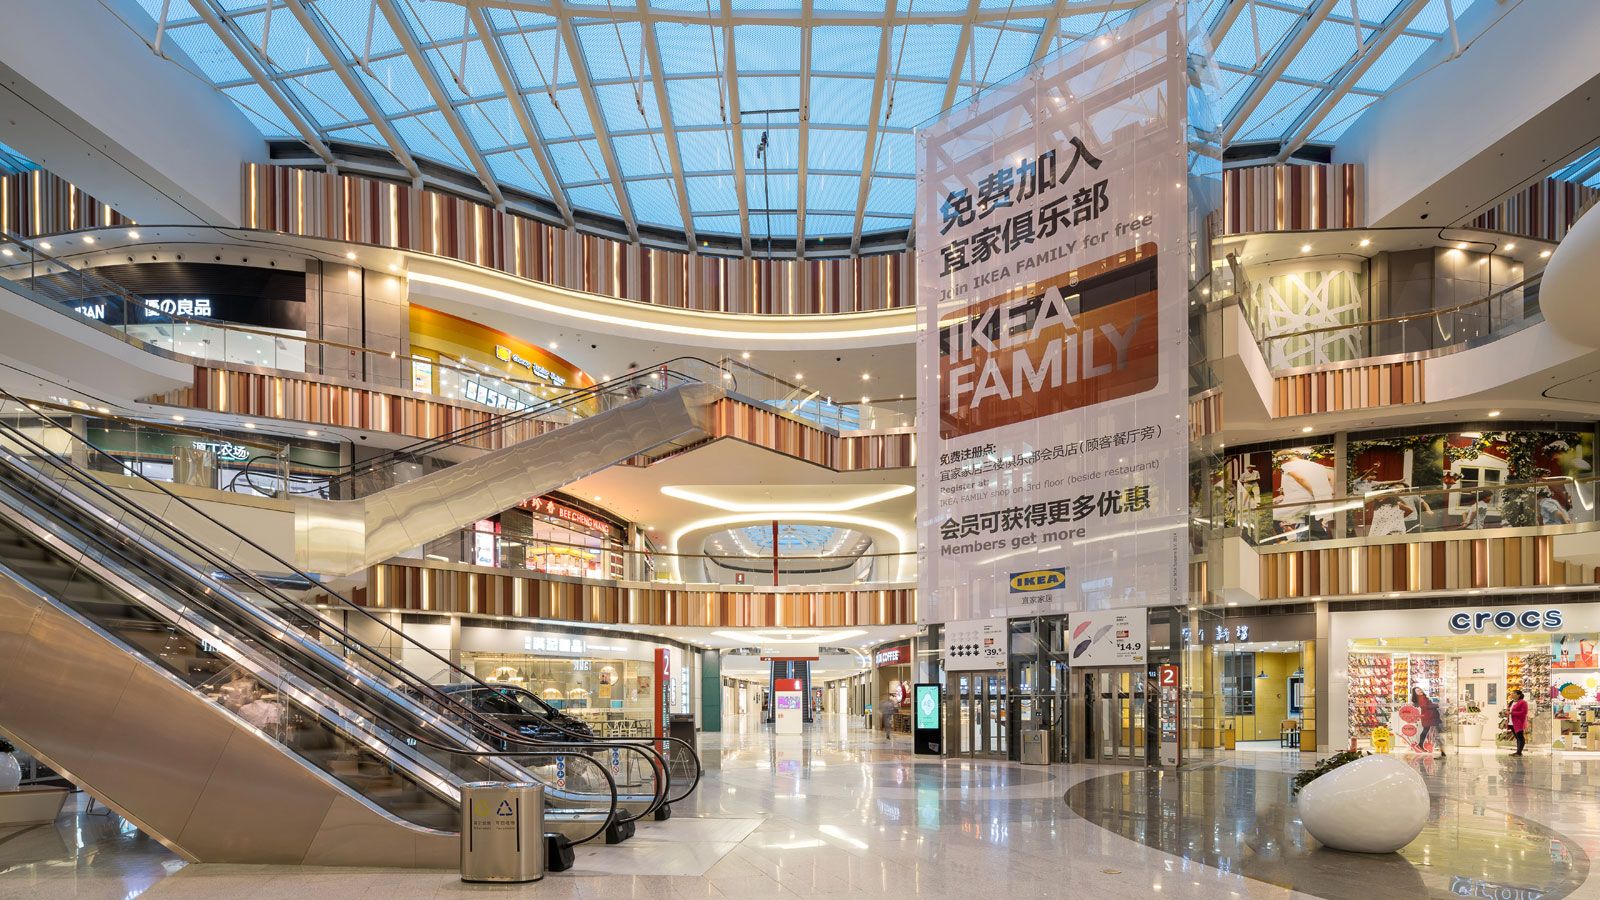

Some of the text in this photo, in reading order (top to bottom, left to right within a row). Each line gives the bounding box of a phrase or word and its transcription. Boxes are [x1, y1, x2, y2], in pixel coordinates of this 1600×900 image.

[940, 136, 1102, 236] 免费加入
[940, 179, 1109, 277] 宜家俱乐部
[940, 214, 1153, 302] Join IKEA FAMILY for free
[950, 285, 1077, 365] IKEA
[950, 313, 1144, 415] FAMILY
[940, 443, 996, 466] 免费注册点:
[940, 459, 1160, 507] IKEA FAMILY shop on 3rd floor (beside restaurant)
[940, 481, 975, 494] Register
[559, 507, 571, 519] BEE
[940, 485, 1150, 541] 会员可获得更多优惠
[941, 525, 1086, 557] Members get more
[1017, 574, 1059, 587] IKEA
[1022, 594, 1053, 605] 宜家家居
[1450, 608, 1562, 631] crocs
[1117, 642, 1141, 651] ¥14.9
[663, 655, 669, 675] 2
[1163, 669, 1174, 684] 2
